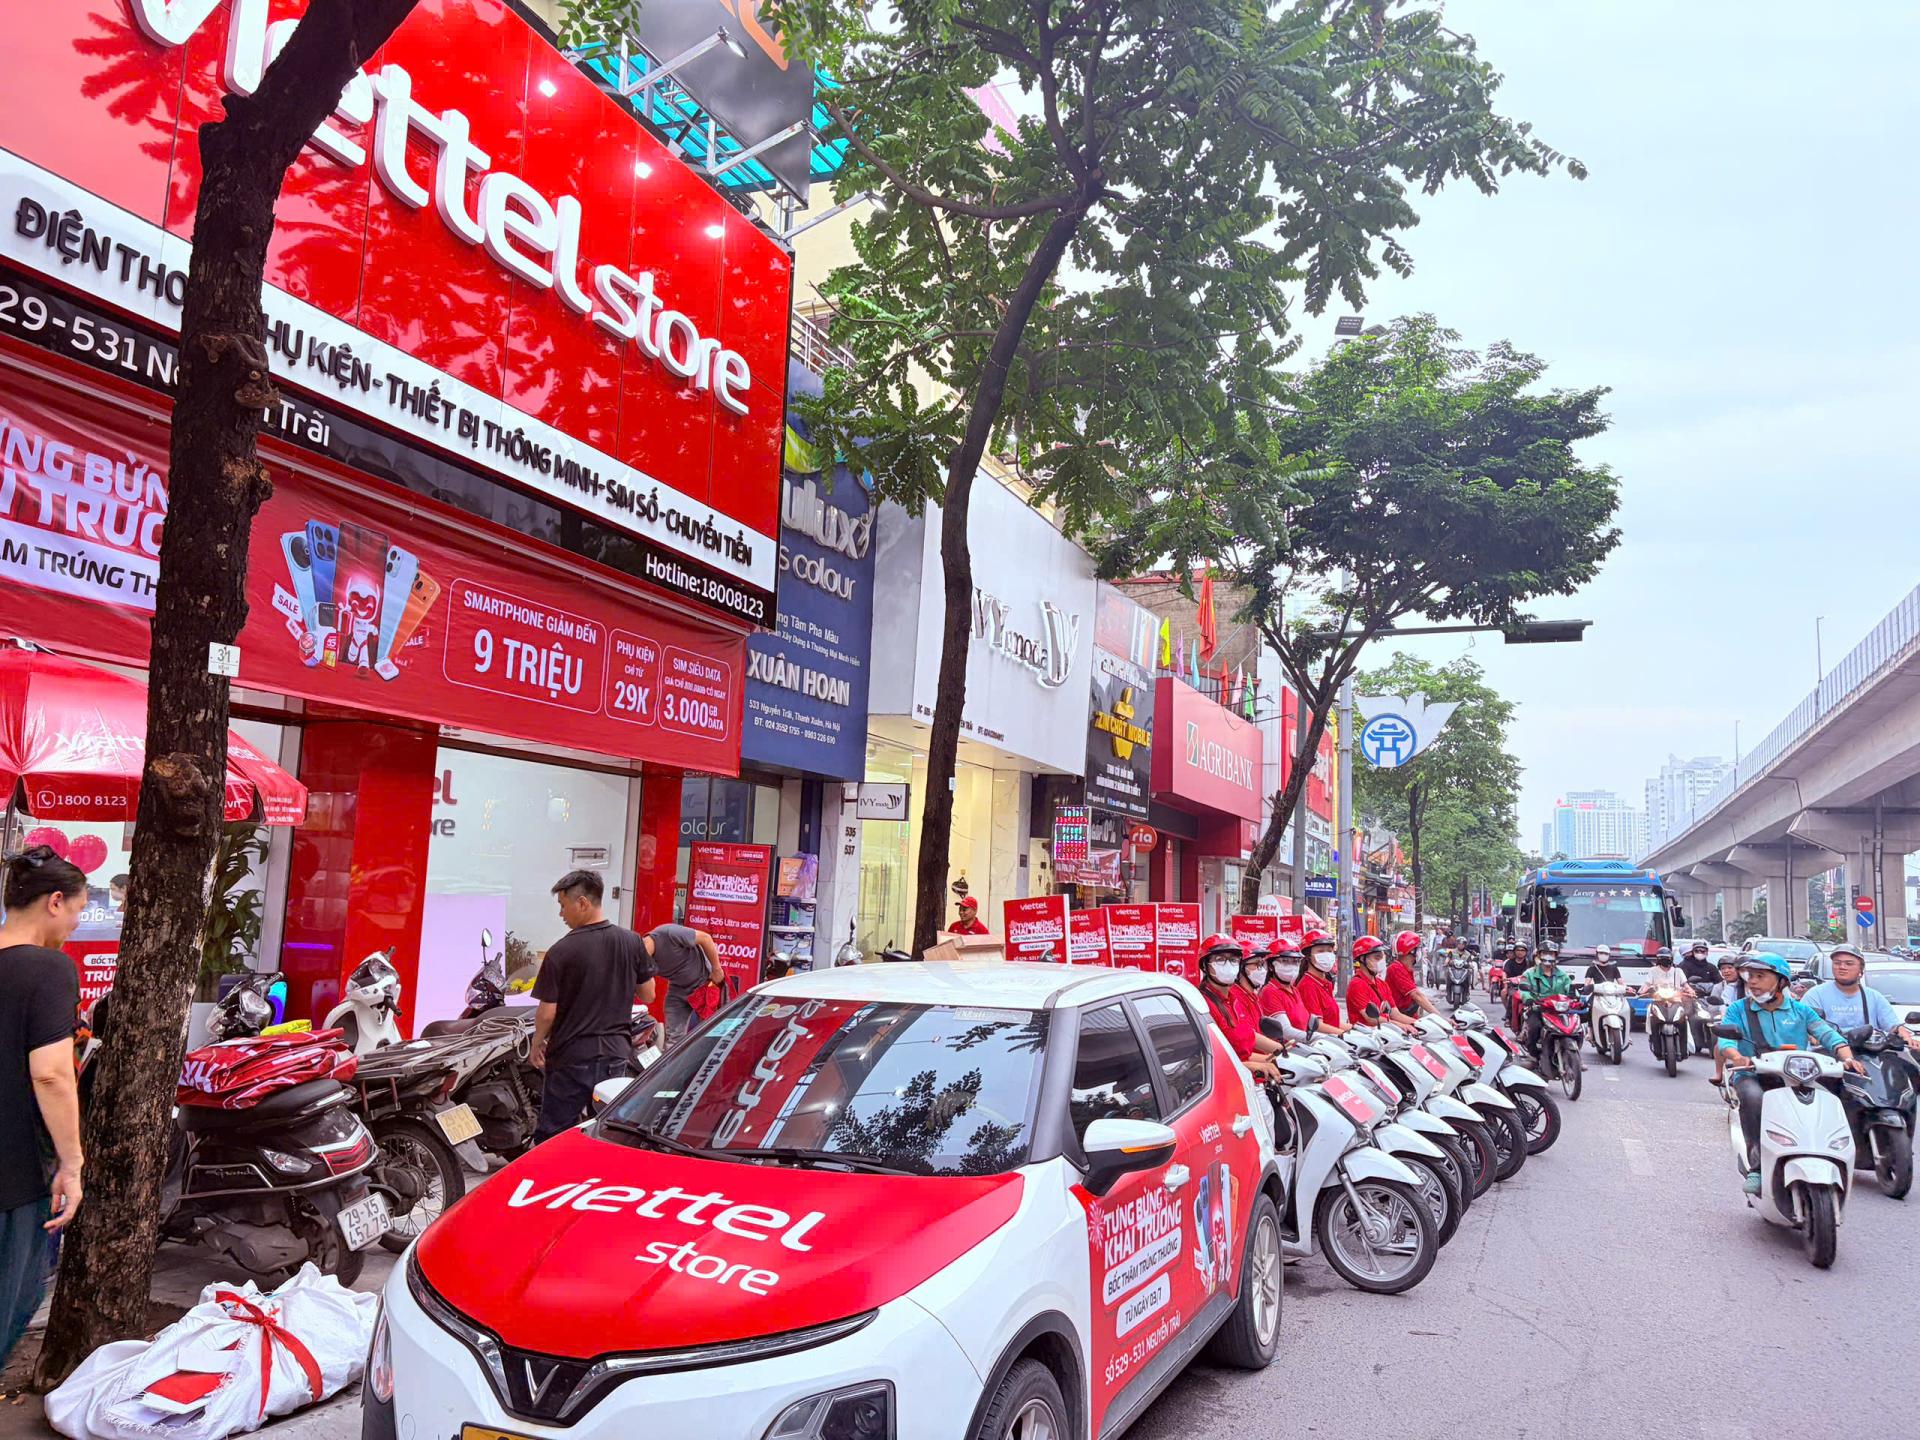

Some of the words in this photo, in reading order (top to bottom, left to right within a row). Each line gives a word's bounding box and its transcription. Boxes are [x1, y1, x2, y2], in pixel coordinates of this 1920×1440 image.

[590, 262, 751, 415] store
[16, 197, 112, 272] ĐIỆN
[117, 242, 188, 306] THO
[262, 313, 304, 367] HỤ
[308, 335, 372, 392] KIỆN
[386, 376, 457, 430] THIẾT
[458, 409, 481, 448] BỊ
[484, 423, 552, 474] THÔNG
[553, 454, 599, 497] MINH
[605, 479, 636, 514] SIM
[636, 487, 659, 523] SỐ
[665, 508, 722, 553] CHUYỂN
[723, 530, 753, 567] TIỀN
[279, 399, 330, 447] Trãi
[0, 418, 74, 483] NG
[84, 451, 169, 514] BỪN
[28, 476, 164, 556] TRƯ
[782, 480, 859, 560] ulux
[34, 550, 125, 590] TRÚNG
[792, 554, 856, 601] colour
[277, 594, 299, 615] SALE
[464, 590, 544, 628] SMARTPHONE
[546, 612, 574, 638] GIẢM
[575, 621, 597, 645] ĐẾN
[808, 622, 823, 637] Pha
[824, 628, 839, 645] Màu
[473, 629, 494, 674] 9
[503, 641, 583, 699] TRIỆU
[616, 640, 634, 659] PHỤ
[635, 643, 655, 664] KIỆN
[673, 657, 687, 672] SIM
[705, 666, 721, 682] DATA
[746, 649, 800, 692] XUÂN
[802, 668, 850, 707] HOAN
[614, 681, 650, 716] 29K
[663, 693, 709, 728] 3.000
[708, 705, 718, 717] GB
[749, 699, 760, 710] 533
[795, 712, 810, 725] Thanh
[707, 717, 724, 732] DATA
[1199, 738, 1254, 792] AGRIBANK
[57, 794, 91, 806] 1800
[95, 795, 127, 807] 8123
[697, 846, 725, 855] viettel
[844, 845, 855, 855] 537
[1133, 828, 1153, 843] ria
[694, 880, 717, 889] KHAI
[718, 881, 758, 893] TRƯƠNG
[689, 915, 710, 927] Galaxy
[710, 917, 724, 926] S26
[724, 918, 740, 928] Ultra
[741, 920, 760, 930] series
[1020, 902, 1047, 911] viettel
[1198, 1120, 1222, 1145] viettel
[345, 1198, 379, 1228] 29-X5
[507, 1177, 826, 1252] viettel
[1135, 1186, 1164, 1220] BỪNG
[349, 1213, 389, 1246] 452.79
[1104, 1225, 1136, 1268] KHAI
[1136, 1199, 1182, 1250] TRƯƠNG
[635, 1240, 780, 1296] store
[1107, 1271, 1122, 1296] BỐC
[1139, 1250, 1158, 1277] TRÚNG
[1133, 1296, 1149, 1319] NGÀY
[1149, 1287, 1162, 1307] 03/7
[1105, 1356, 1116, 1385] SỐ
[1115, 1359, 1128, 1379] 529
[1133, 1347, 1146, 1364] 531
[1145, 1319, 1169, 1355] NGUYỄN
